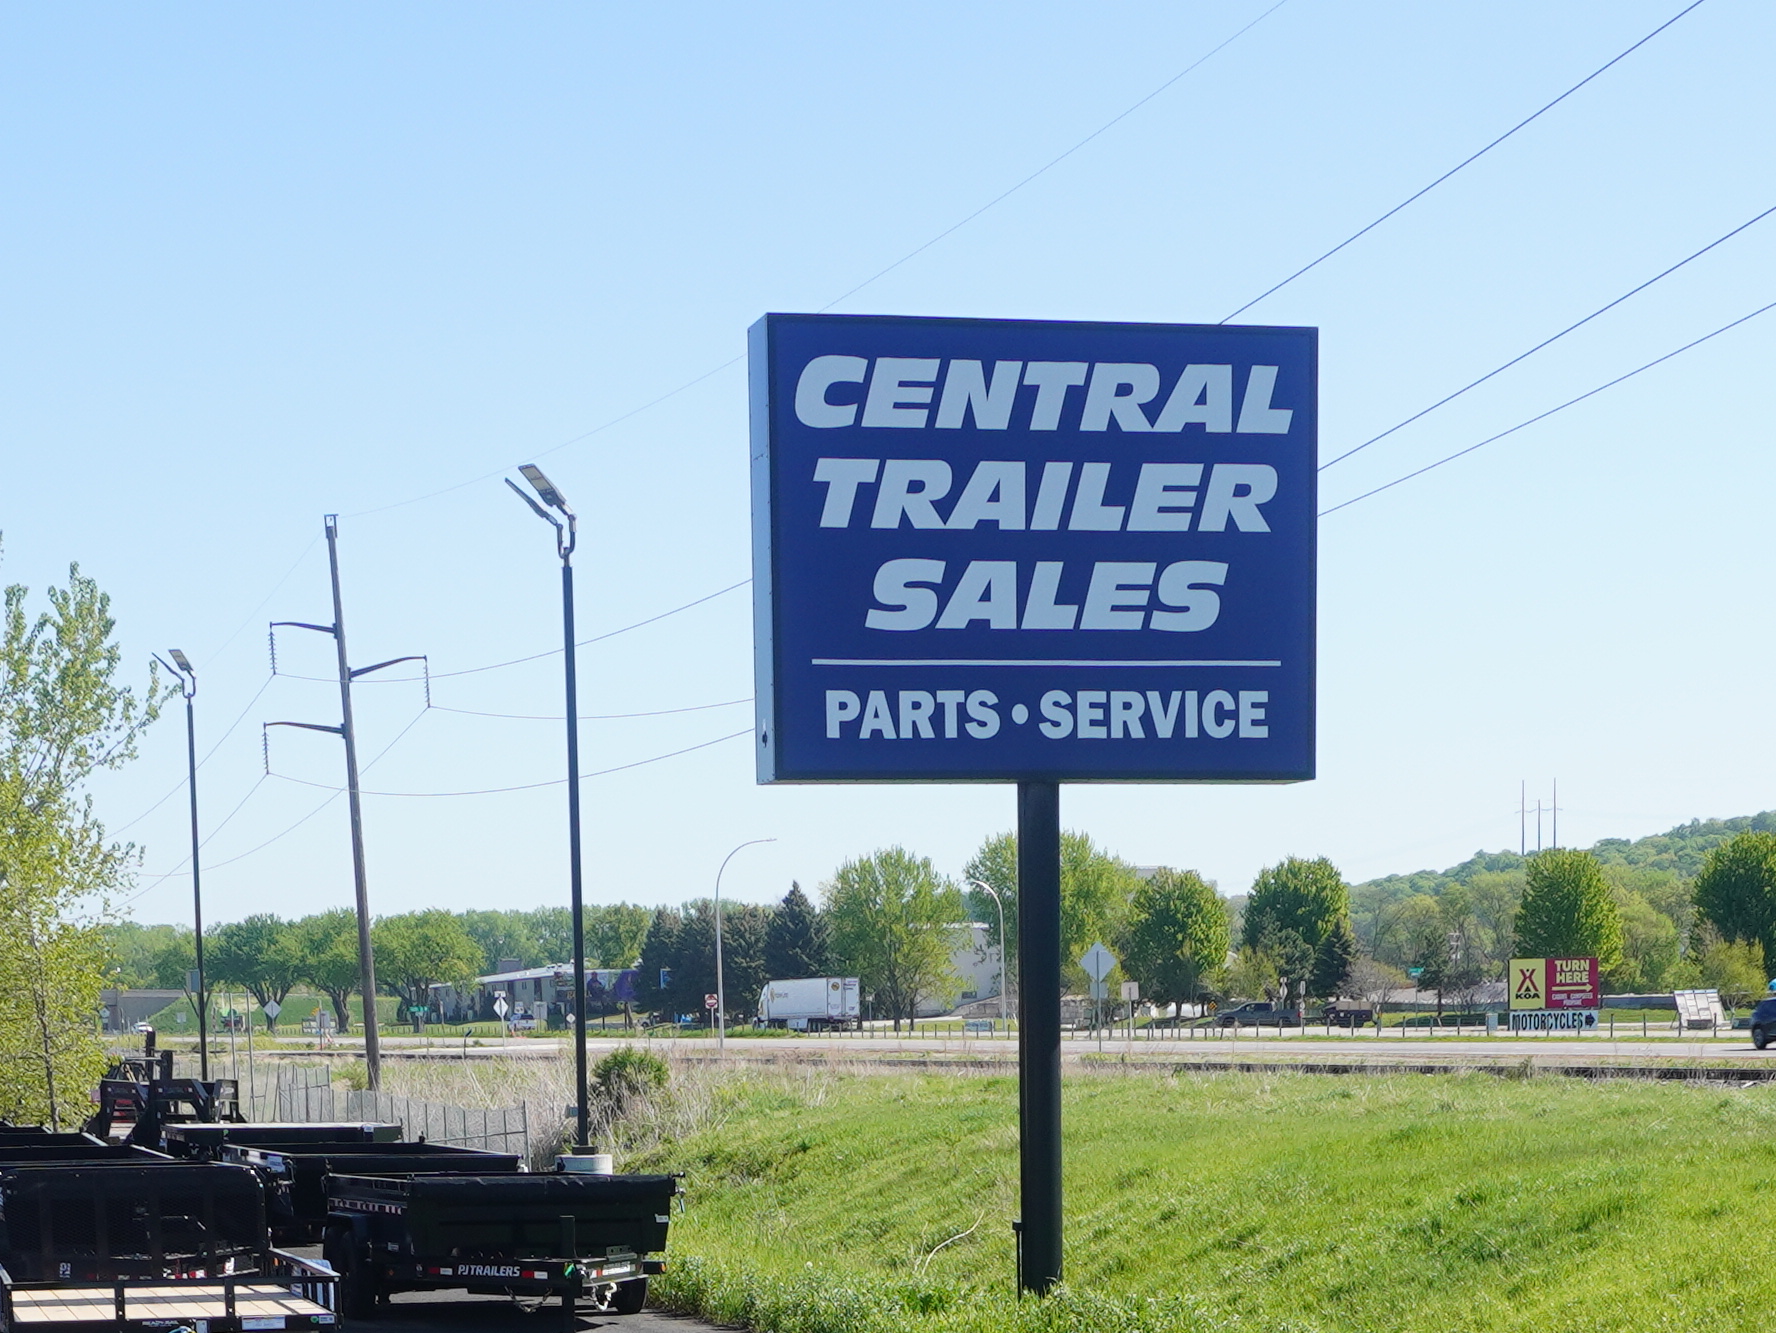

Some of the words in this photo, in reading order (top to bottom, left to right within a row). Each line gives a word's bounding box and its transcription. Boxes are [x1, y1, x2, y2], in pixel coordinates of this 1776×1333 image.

[794, 355, 1294, 434] CENTRAL
[812, 457, 1279, 532] TRAILER
[864, 558, 1229, 632] SALES
[825, 689, 1001, 740] PARTS
[1038, 689, 1269, 740] SERVICE
[1554, 959, 1590, 972] TURN
[1555, 971, 1590, 984] HERE
[1515, 992, 1541, 1000] KOA
[1512, 1011, 1584, 1031] MOTORCYCLES
